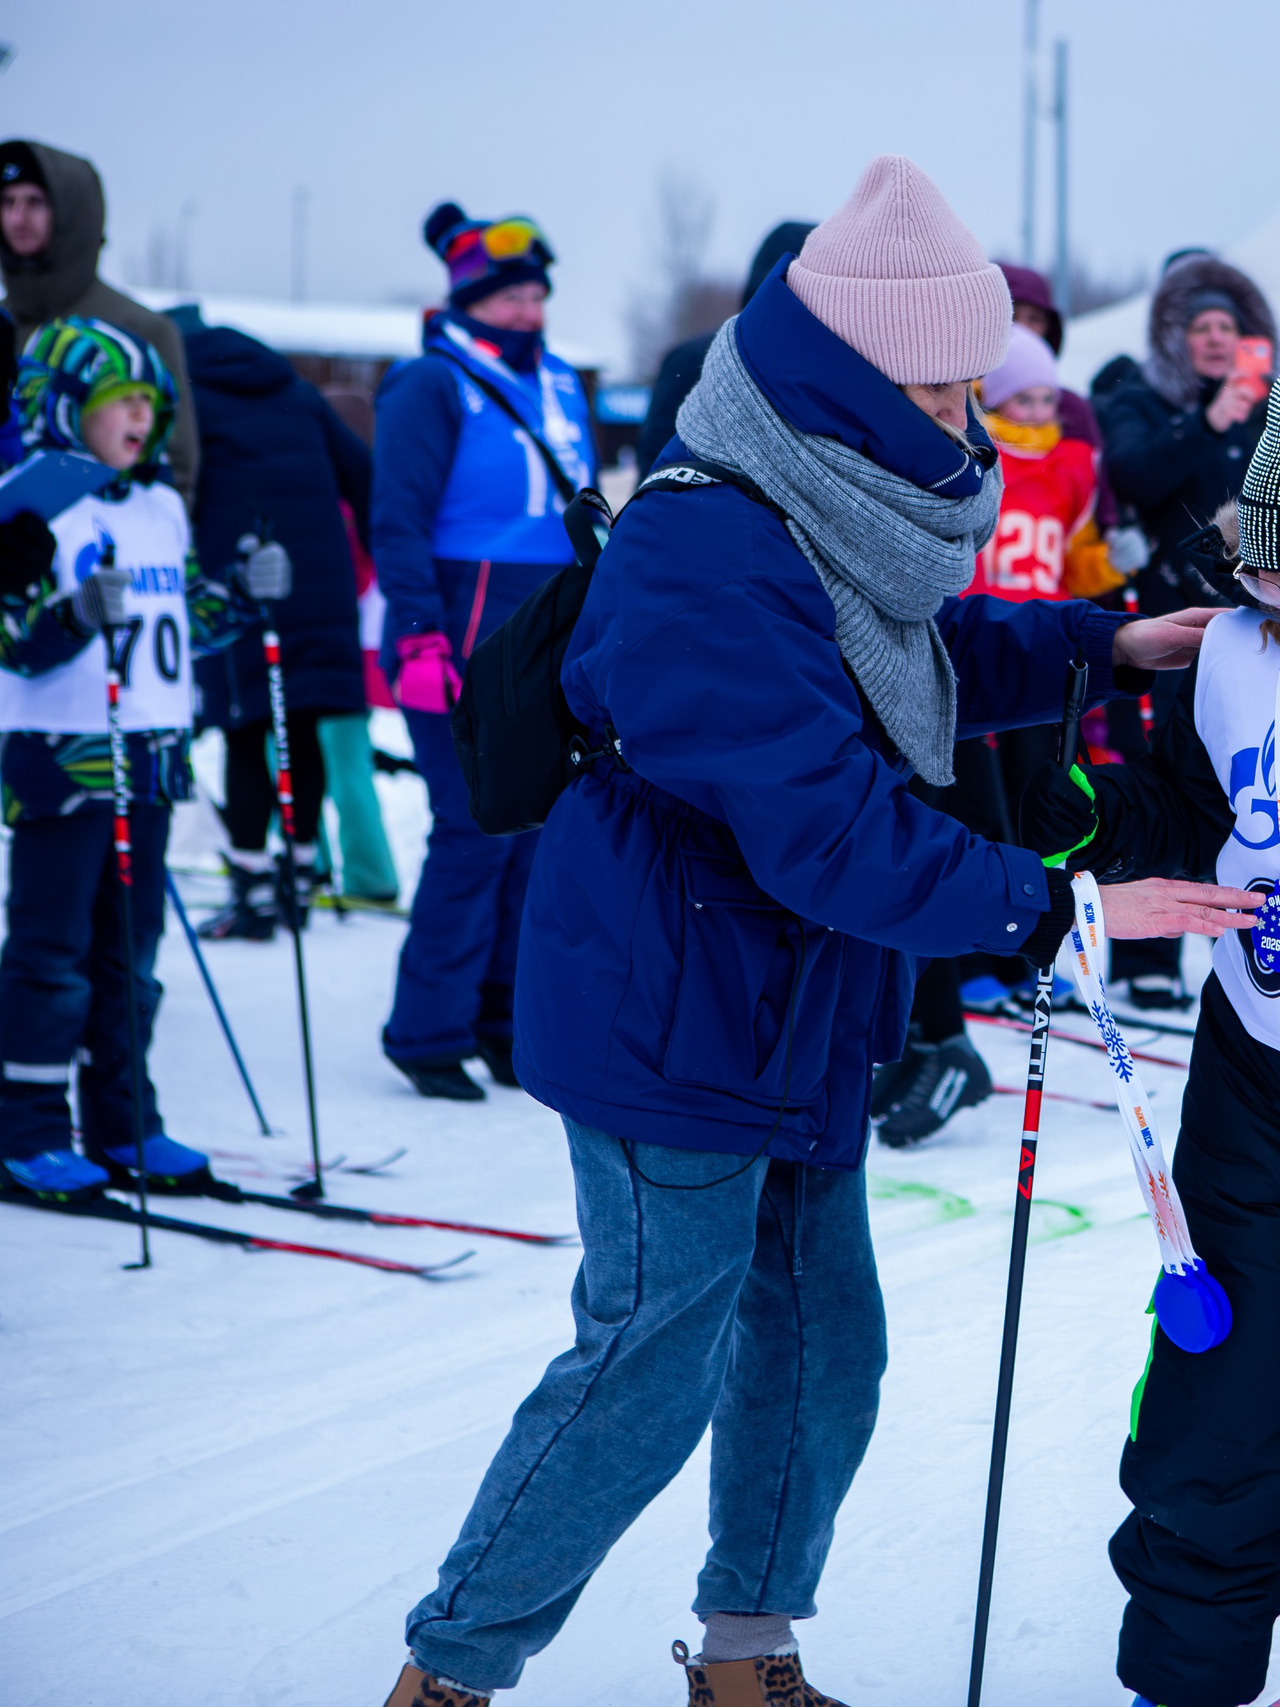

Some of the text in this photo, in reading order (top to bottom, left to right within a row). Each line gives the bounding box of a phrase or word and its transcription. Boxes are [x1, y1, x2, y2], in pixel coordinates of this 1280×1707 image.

[114, 613, 180, 687] 70
[1083, 902, 1096, 924] МОЭК
[1071, 930, 1085, 953] МОЭК
[1261, 935, 1280, 952] 2026
[1140, 1126, 1154, 1149] МОЭК
[1018, 1145, 1036, 1200] A7
